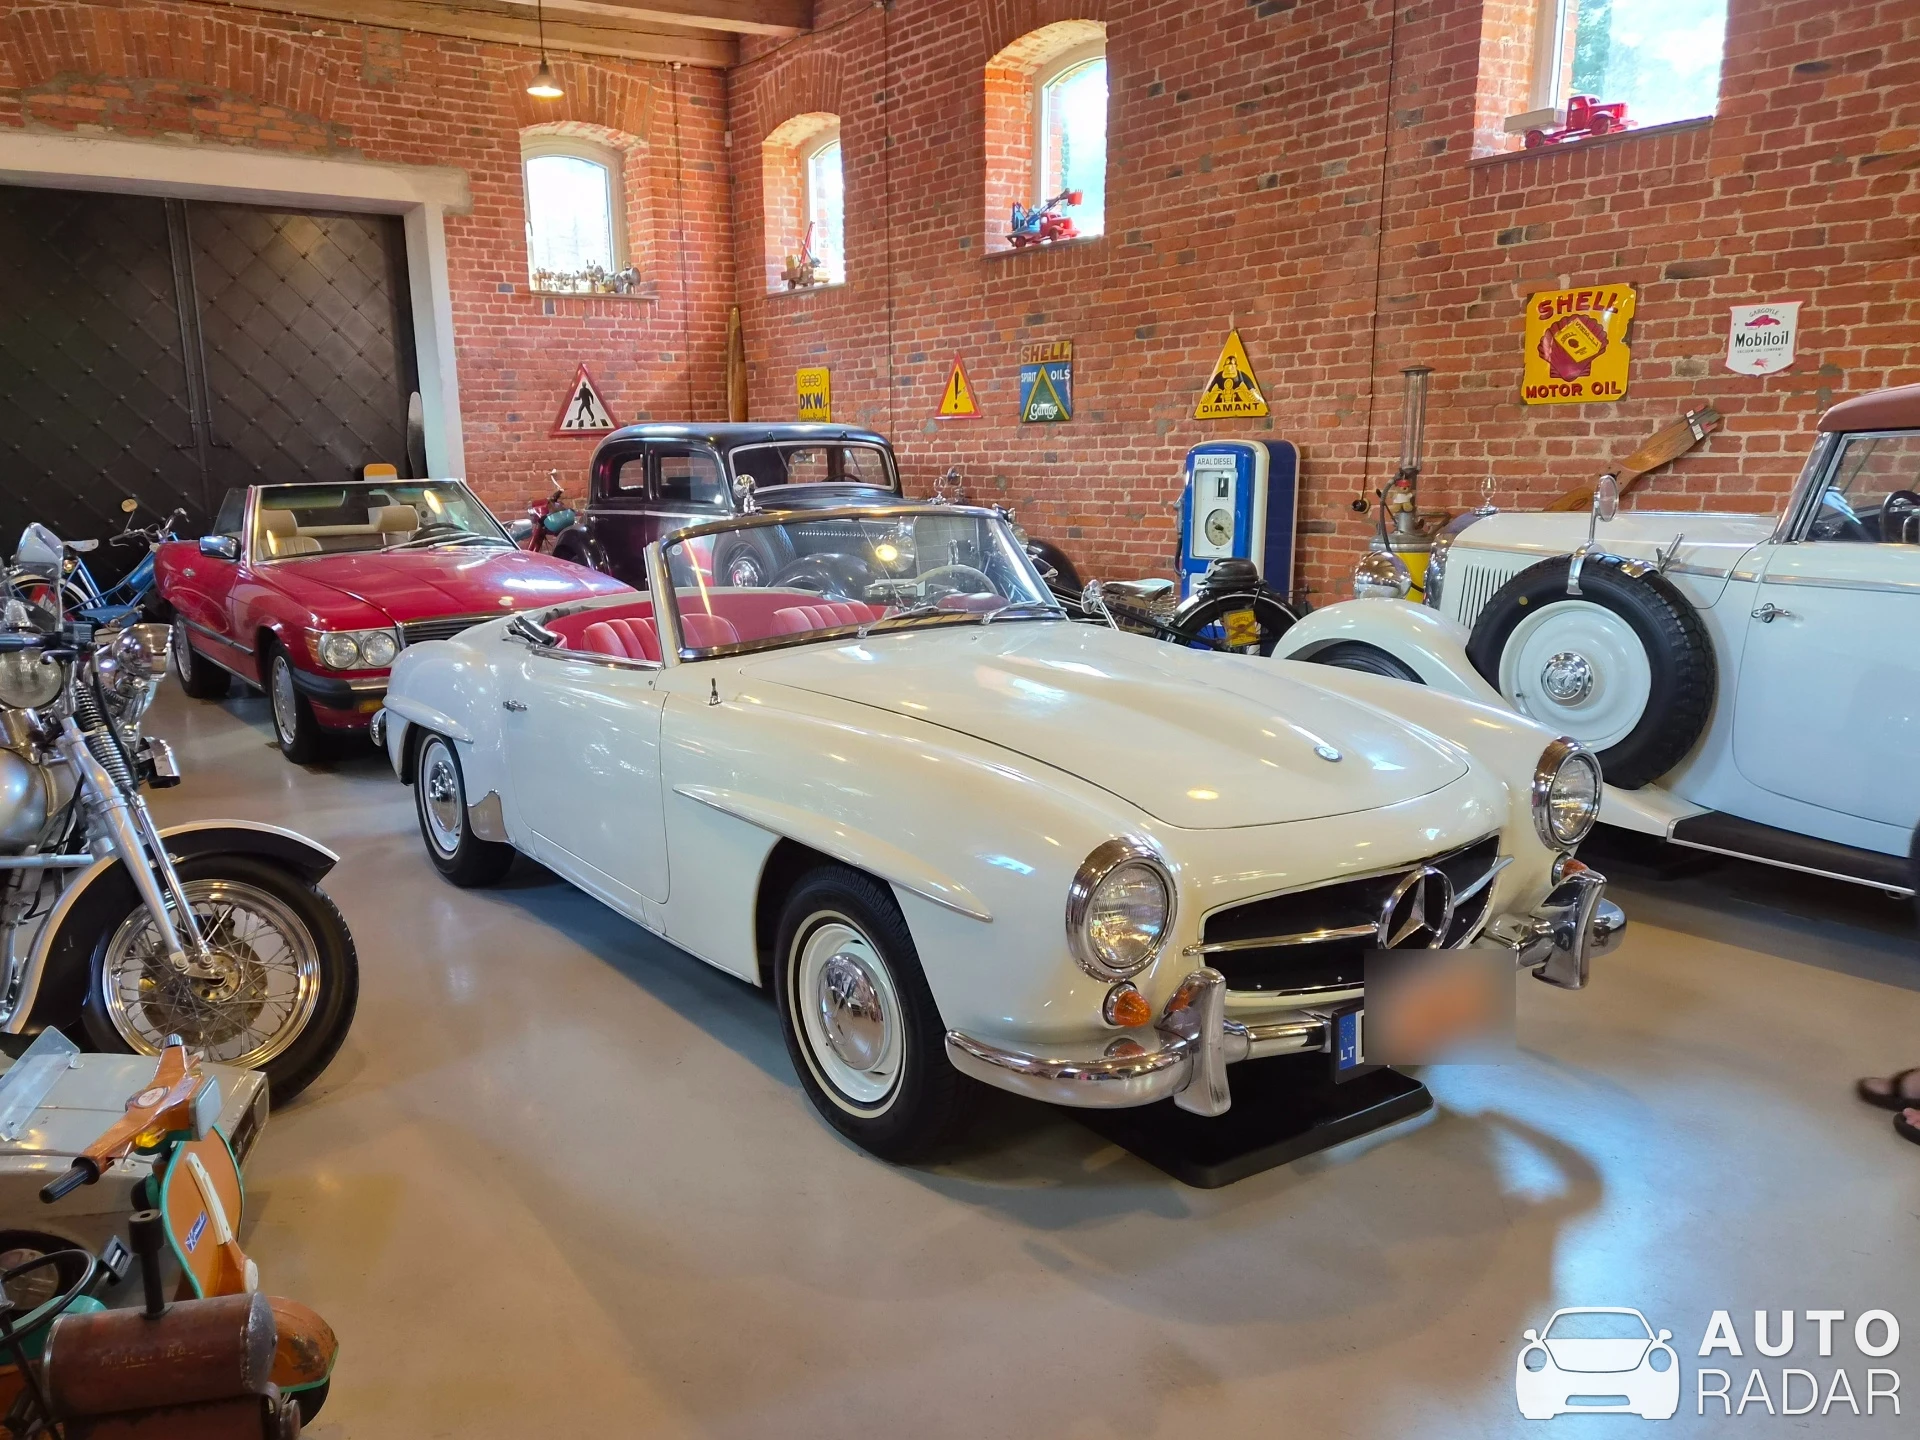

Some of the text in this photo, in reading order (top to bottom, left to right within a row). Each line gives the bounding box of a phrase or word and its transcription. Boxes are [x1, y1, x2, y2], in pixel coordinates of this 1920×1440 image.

[1538, 291, 1619, 320] SHELL
[1749, 307, 1779, 317] GARGOYLE
[1735, 330, 1789, 348] Mobiloil
[1021, 342, 1070, 363] SHELL
[1021, 371, 1037, 383] SPIRIT
[1050, 369, 1071, 380] OILS
[1525, 381, 1622, 399] MOTOR OIL
[800, 392, 823, 410] DKW
[1202, 402, 1260, 413] DIAMANT
[1029, 403, 1058, 420] Garage
[1197, 457, 1233, 465] ARAL DIESEL
[1340, 1045, 1355, 1061] LT
